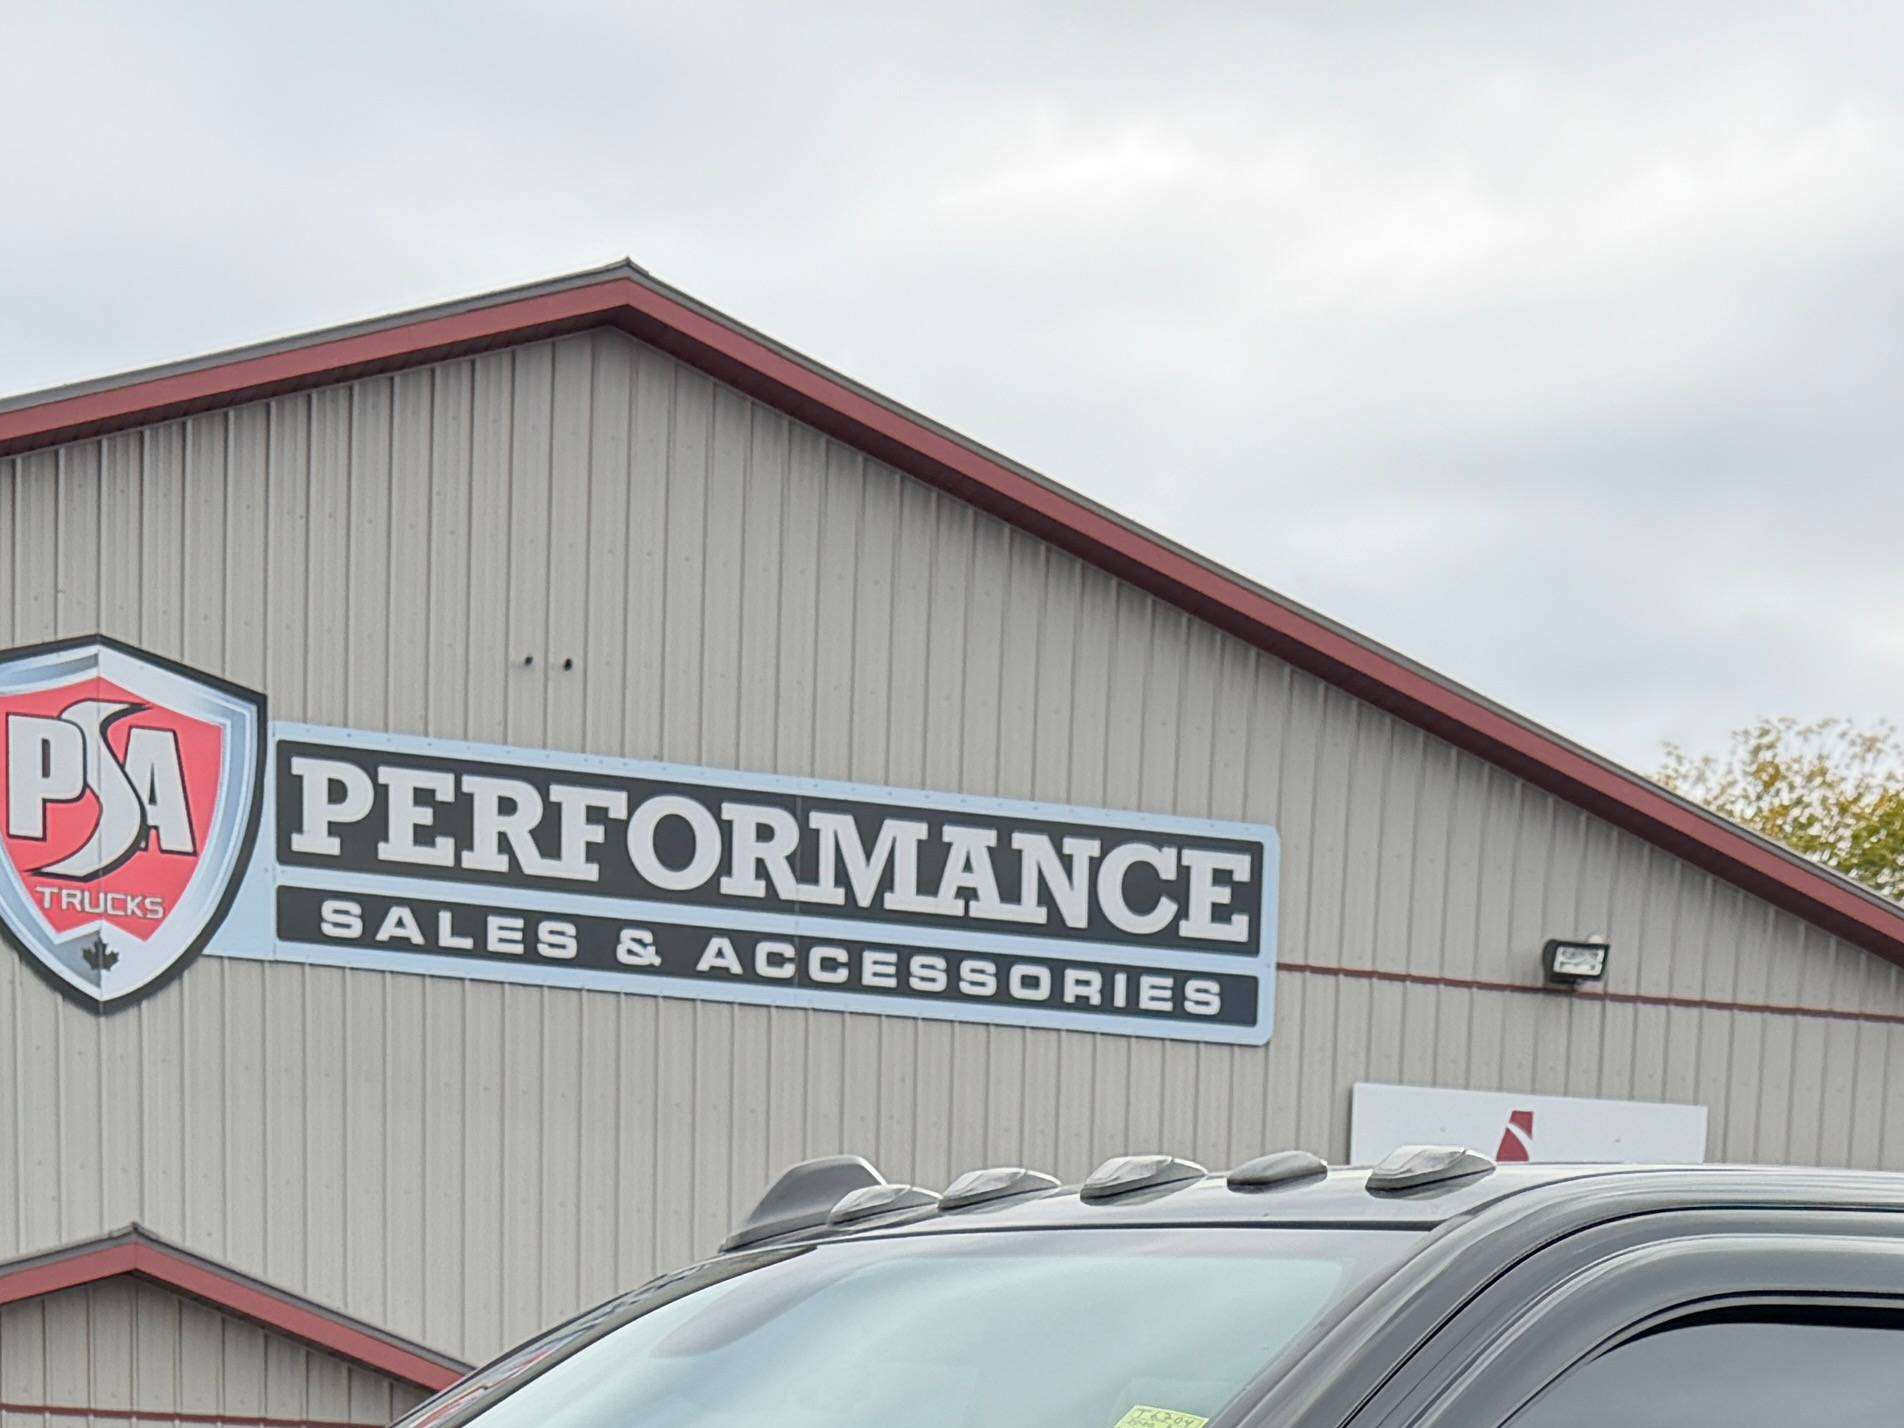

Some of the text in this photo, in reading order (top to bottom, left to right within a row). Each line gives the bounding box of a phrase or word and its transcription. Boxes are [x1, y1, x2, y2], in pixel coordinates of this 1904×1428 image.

[5, 697, 199, 883] PSA
[291, 756, 1252, 943] PERFORMANCE
[36, 886, 164, 919] TRUCKS
[321, 900, 1223, 1016] SALES & ACCESSORIES
